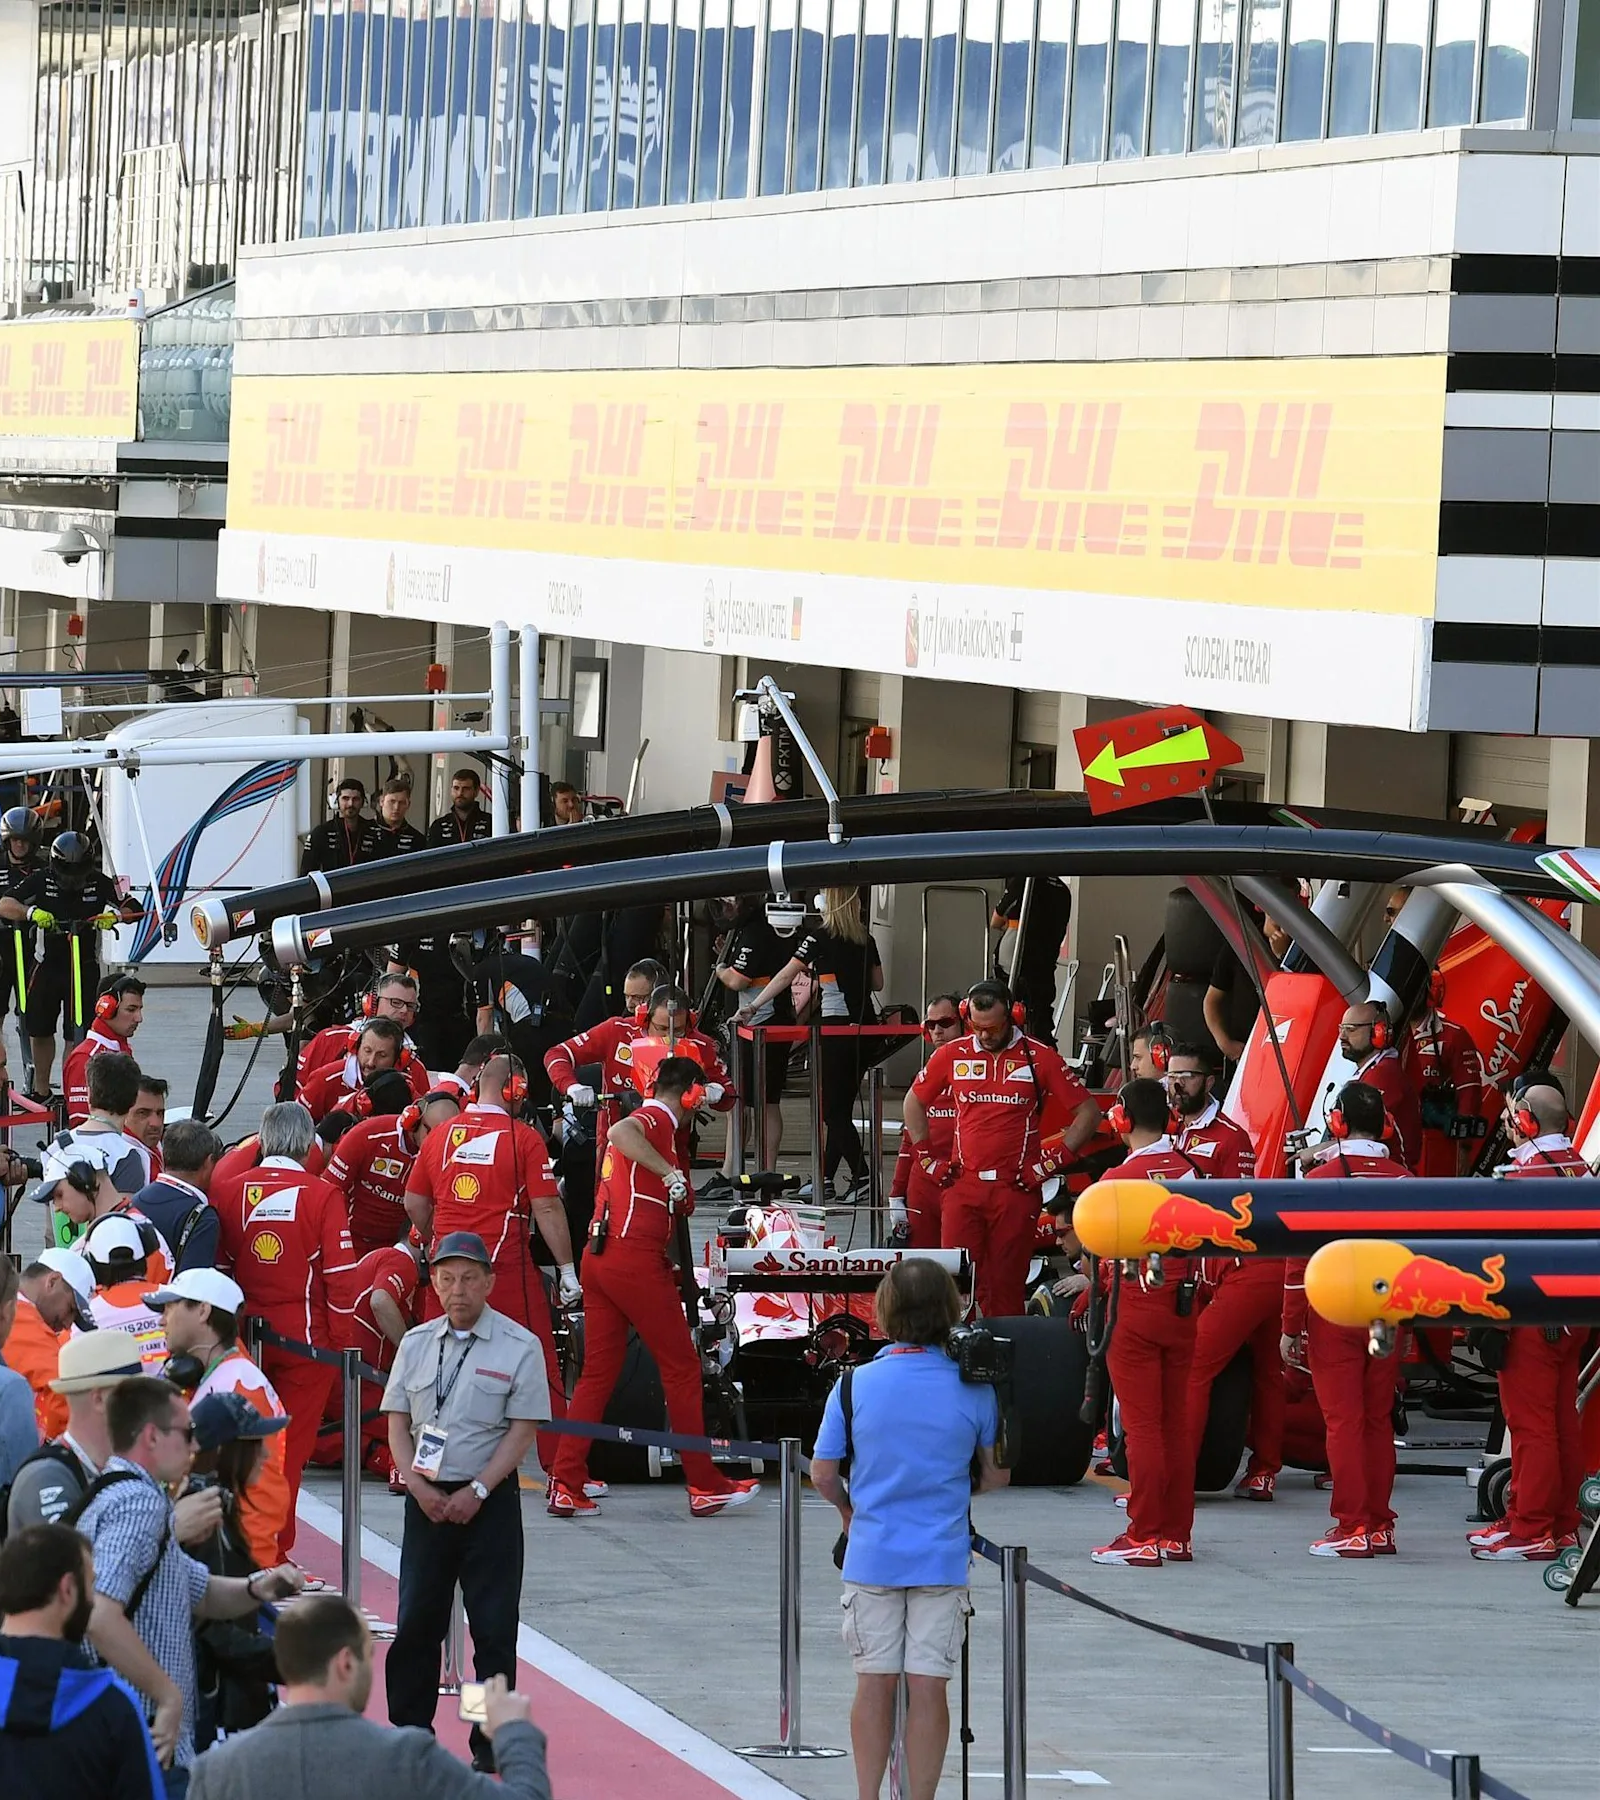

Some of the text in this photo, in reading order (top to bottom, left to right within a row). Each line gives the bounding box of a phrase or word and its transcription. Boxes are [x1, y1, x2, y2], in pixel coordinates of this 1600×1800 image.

[731, 600, 766, 636] SEBASTIAN
[923, 608, 1007, 660] 07 KIMI RÄIKKÖNEN
[1184, 635, 1272, 685] SCUDERIA FERRARI
[778, 726, 791, 768] FXTM
[968, 1090, 1030, 1105] Santander
[928, 1107, 956, 1118] Santa
[374, 1184, 406, 1206] Santa
[788, 1251, 903, 1272] Santand
